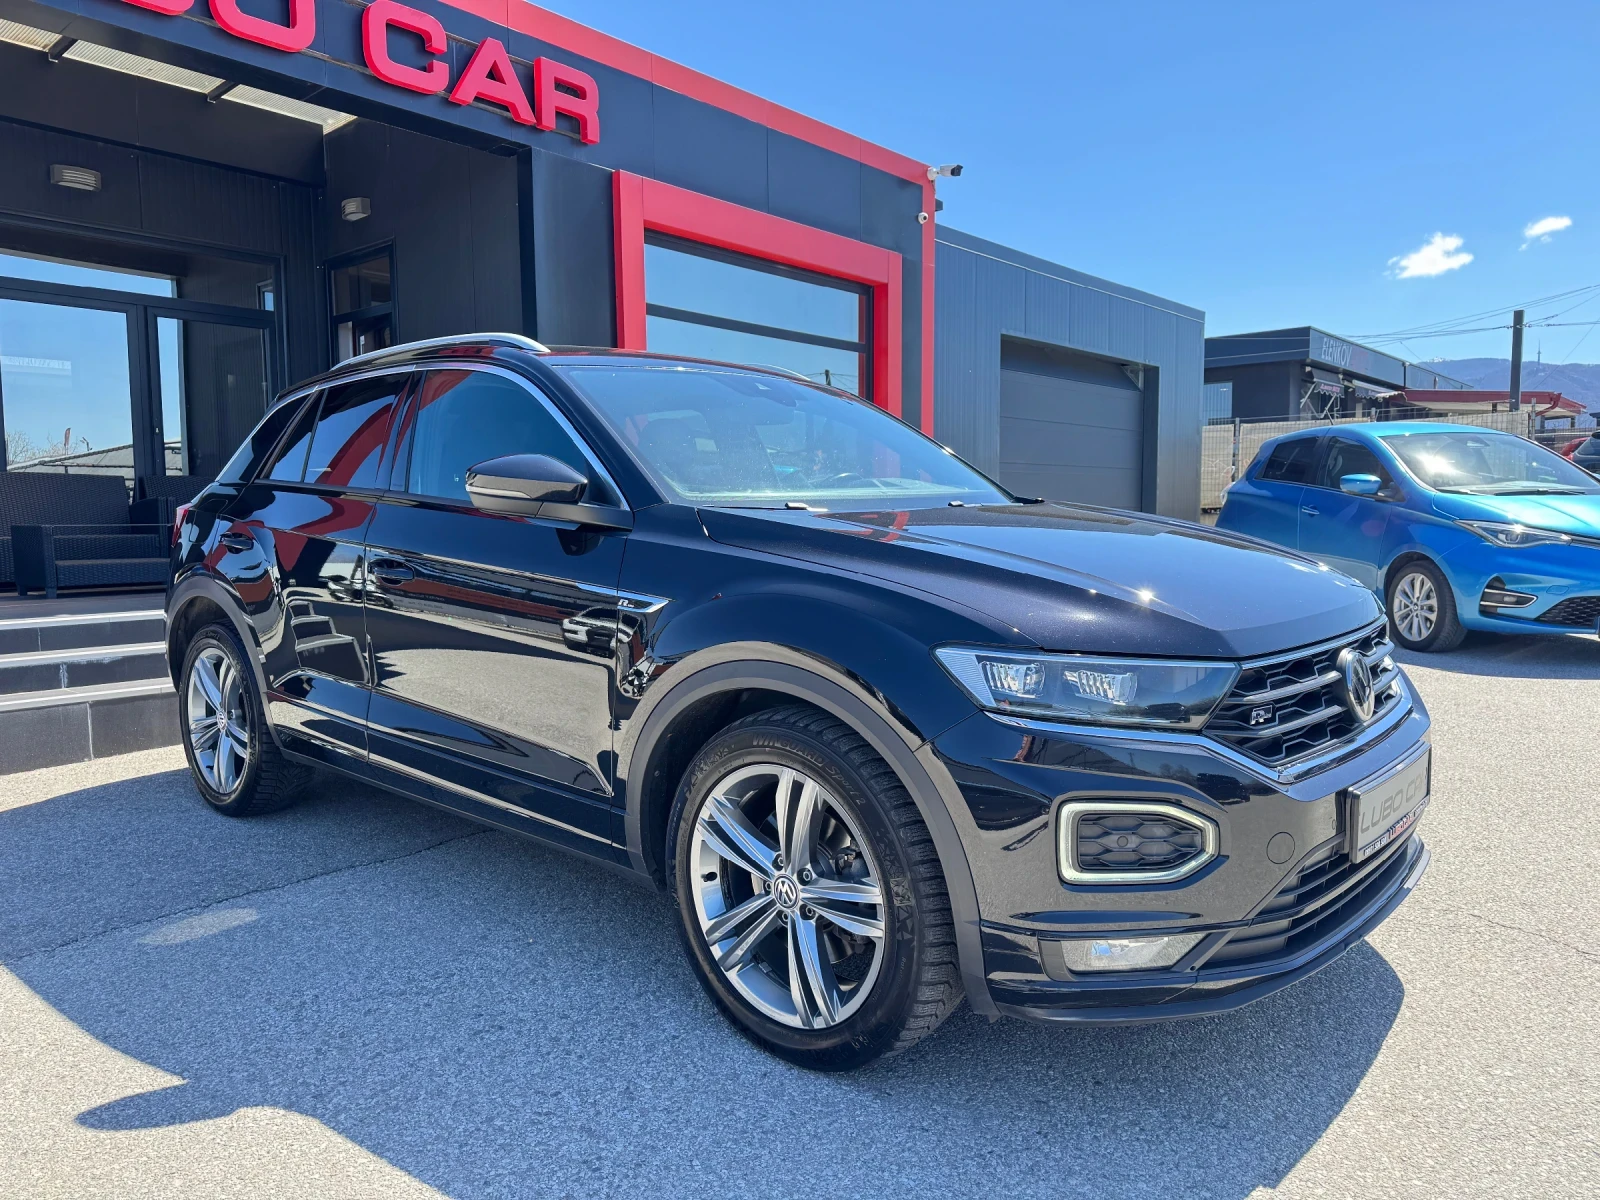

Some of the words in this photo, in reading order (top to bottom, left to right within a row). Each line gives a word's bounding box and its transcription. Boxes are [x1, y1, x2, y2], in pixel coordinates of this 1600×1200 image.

[362, 0, 600, 145] CAR
[1321, 337, 1352, 367] ELENKOV
[825, 765, 861, 797] Sport
[855, 796, 866, 806] 2
[1361, 788, 1403, 834] LUBO
